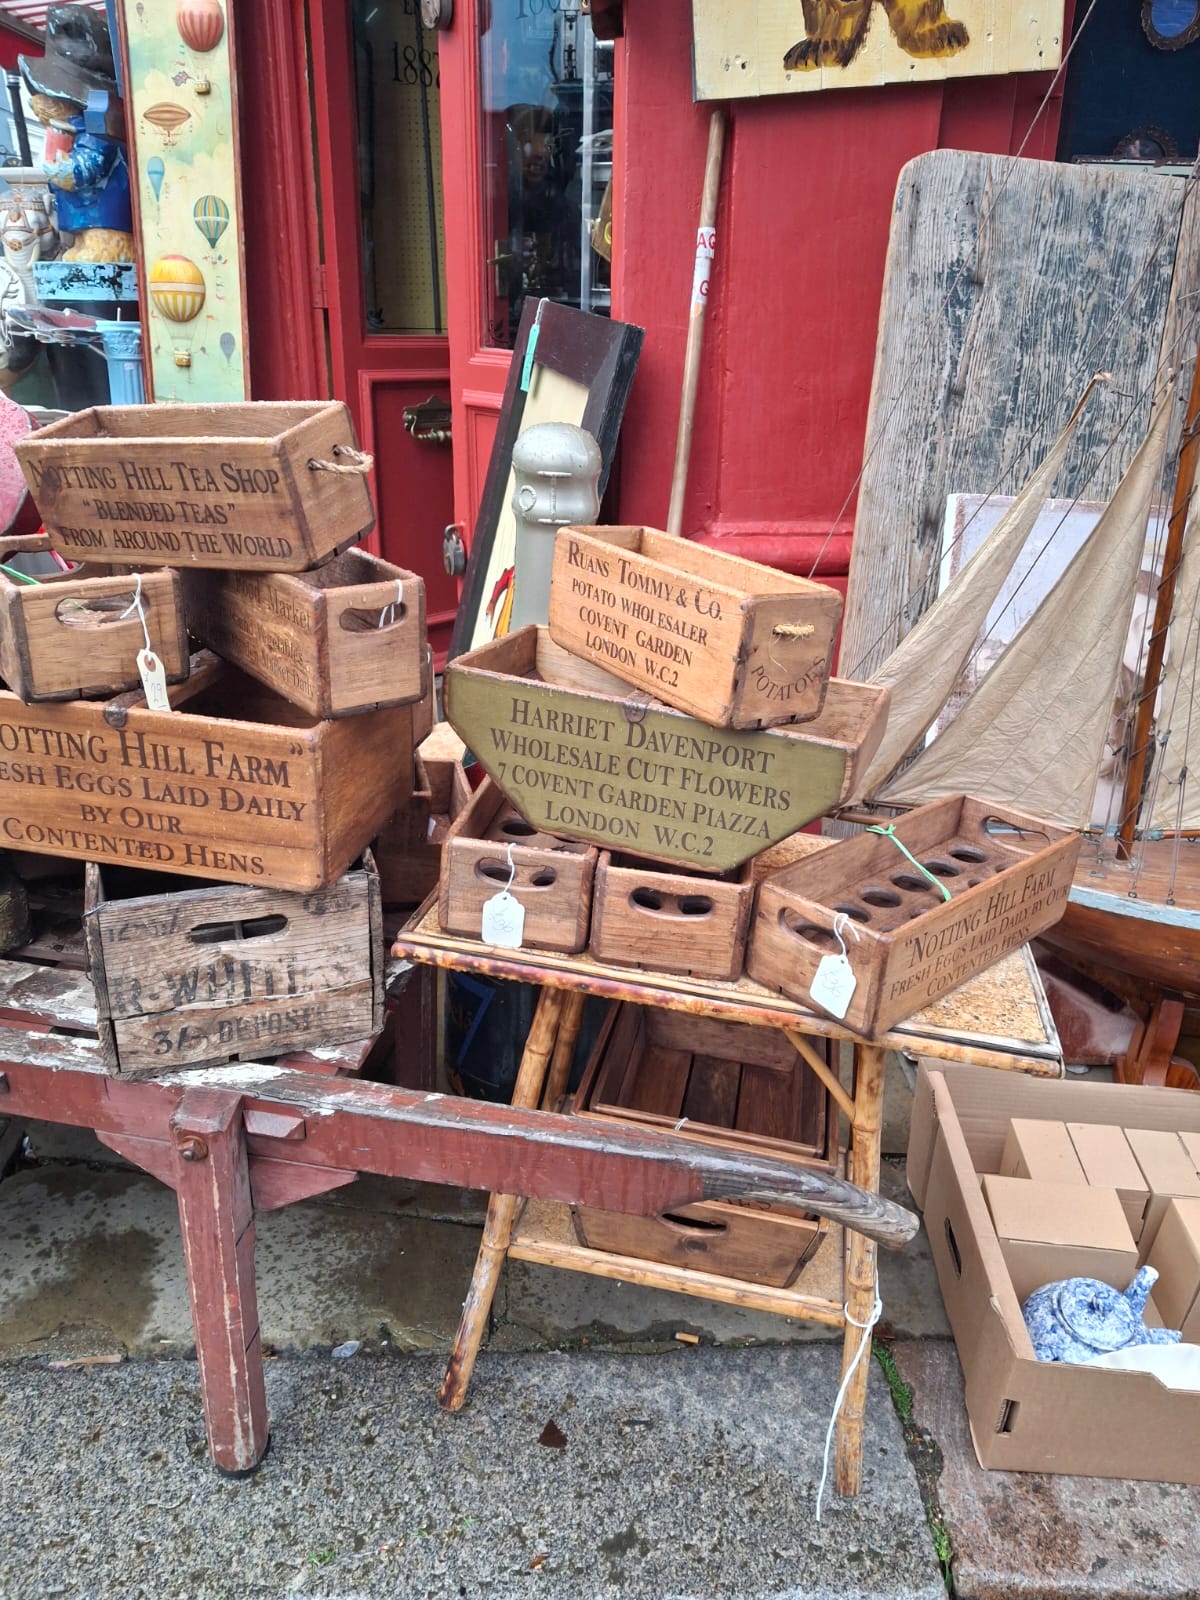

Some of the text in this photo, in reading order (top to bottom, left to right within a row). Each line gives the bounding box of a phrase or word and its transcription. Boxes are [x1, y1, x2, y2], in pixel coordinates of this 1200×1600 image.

[27, 460, 280, 494] NOTTING HILL TEA SHOP
[56, 526, 293, 559] FROM AROUND THE WORLD
[567, 541, 723, 621] RUANS TOMMY & CO.
[572, 577, 707, 646] POTATO WHOLESALER
[579, 605, 692, 667] COVENT GARDEN
[586, 631, 679, 688] LONDON W.C.2
[751, 655, 826, 701] POTATOES
[117, 729, 195, 776] HILL
[510, 697, 776, 775] HARRIET DAVENPORT
[54, 764, 132, 798] EGGS
[142, 776, 209, 808] LAID
[217, 787, 308, 822] DAILY
[490, 727, 791, 811] WHOLESALE CUT FLOWERS
[80, 804, 184, 836] BY OUR
[498, 762, 771, 840] 7 COVENT GARDEN PIAZZA
[546, 800, 714, 857] LONDON W.C.2
[3, 816, 273, 877] CONTENTED HENS.
[984, 890, 1017, 926] HILL
[889, 885, 1068, 1001] FRESH EGGS LAID DAILY BY OUR
[926, 922, 1031, 998] CONTENTED HENS
